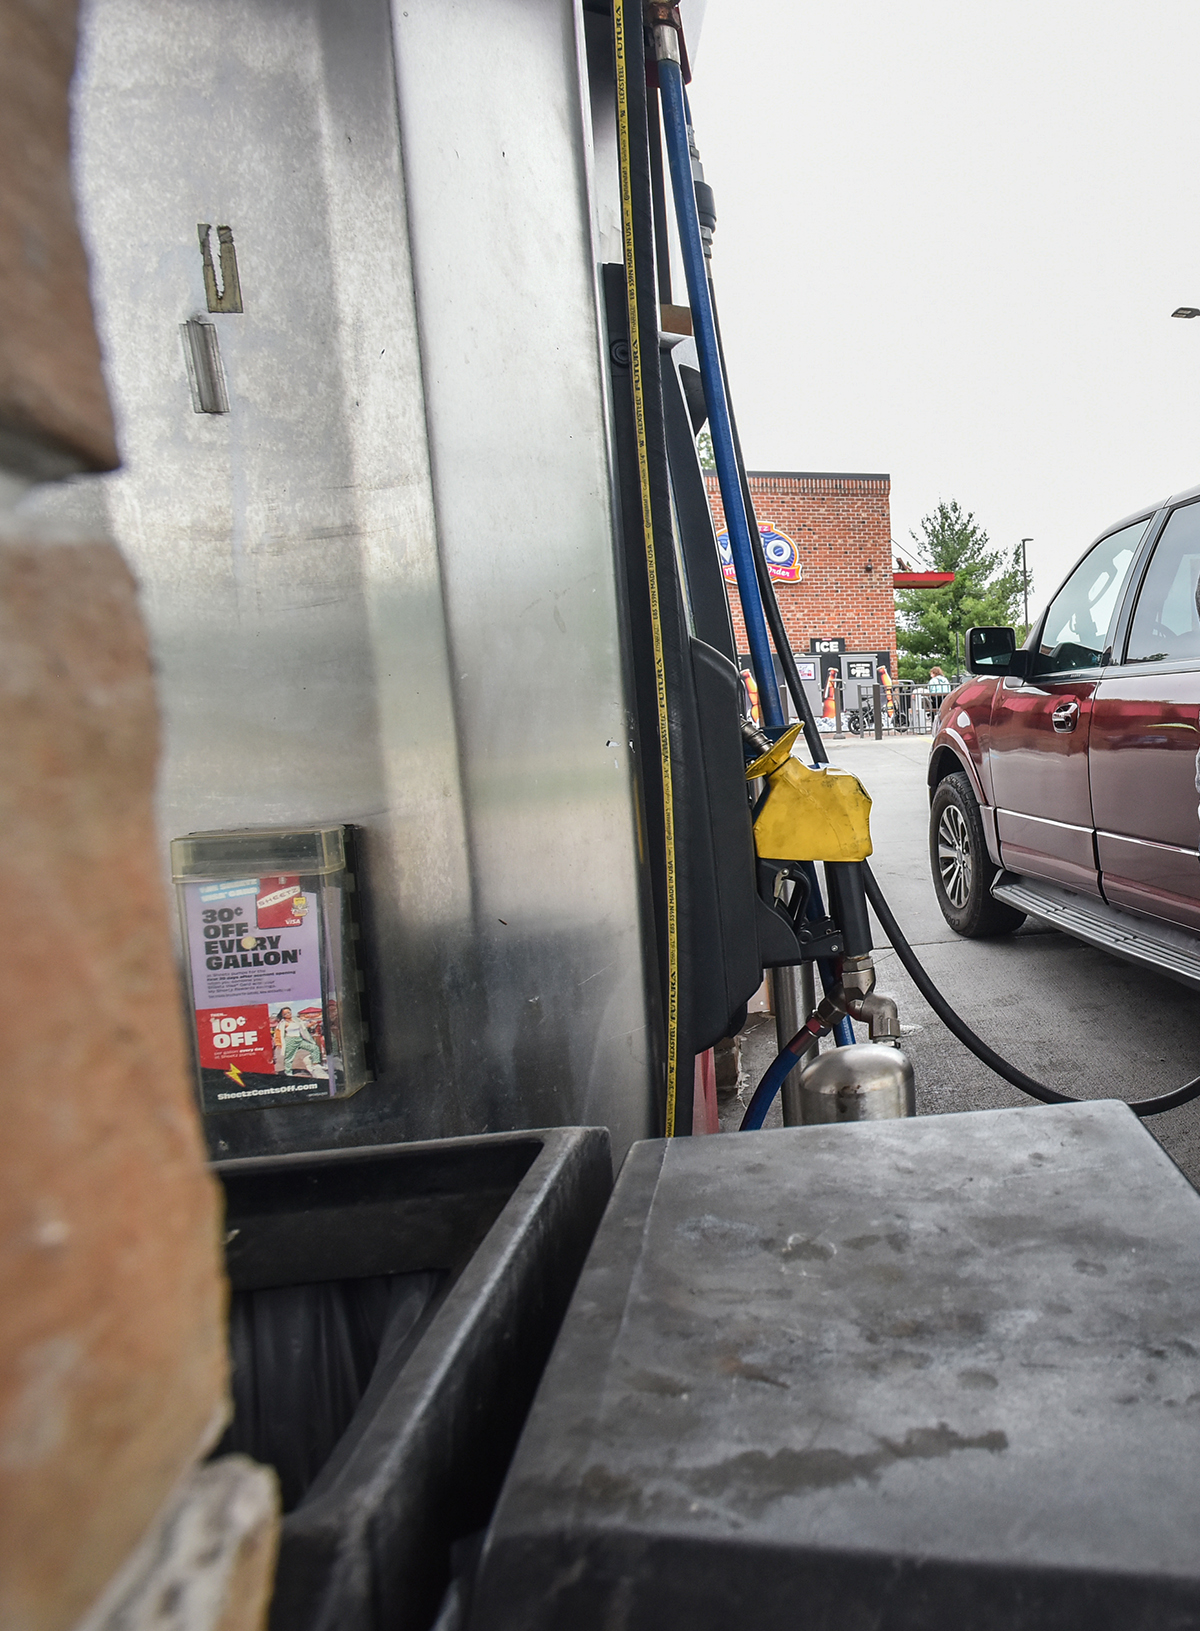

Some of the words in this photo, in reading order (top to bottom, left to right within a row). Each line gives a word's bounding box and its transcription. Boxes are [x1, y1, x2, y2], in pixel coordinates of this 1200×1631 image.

[815, 642, 839, 652] ICE
[258, 886, 300, 907] SHEETZ
[202, 907, 243, 924] 30¢
[203, 923, 248, 939] OFF
[210, 1016, 246, 1033] 10¢
[213, 1031, 258, 1048] OFF
[217, 1083, 317, 1100] SheetzCentsOff.com
